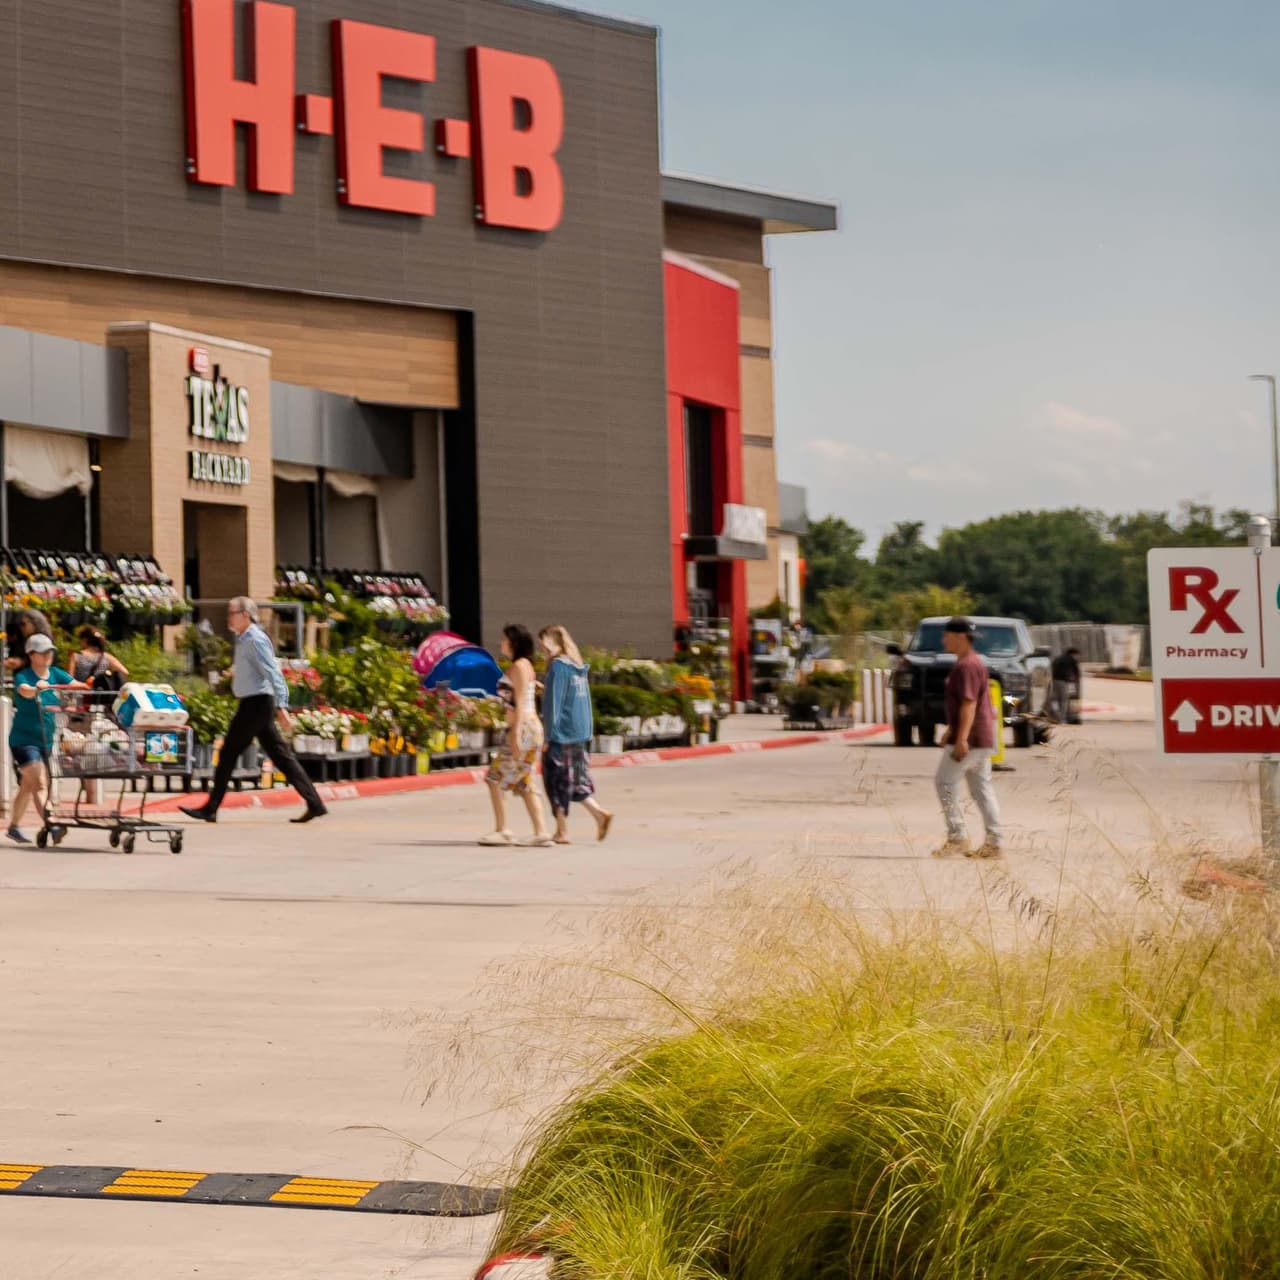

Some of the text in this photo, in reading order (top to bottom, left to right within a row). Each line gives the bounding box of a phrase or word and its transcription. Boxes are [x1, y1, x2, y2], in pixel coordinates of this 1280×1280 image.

[186, 375, 249, 444] TEXAS
[189, 451, 251, 486] BACKYARD
[1167, 566, 1245, 634] Rx
[1166, 646, 1249, 660] Pharmacy
